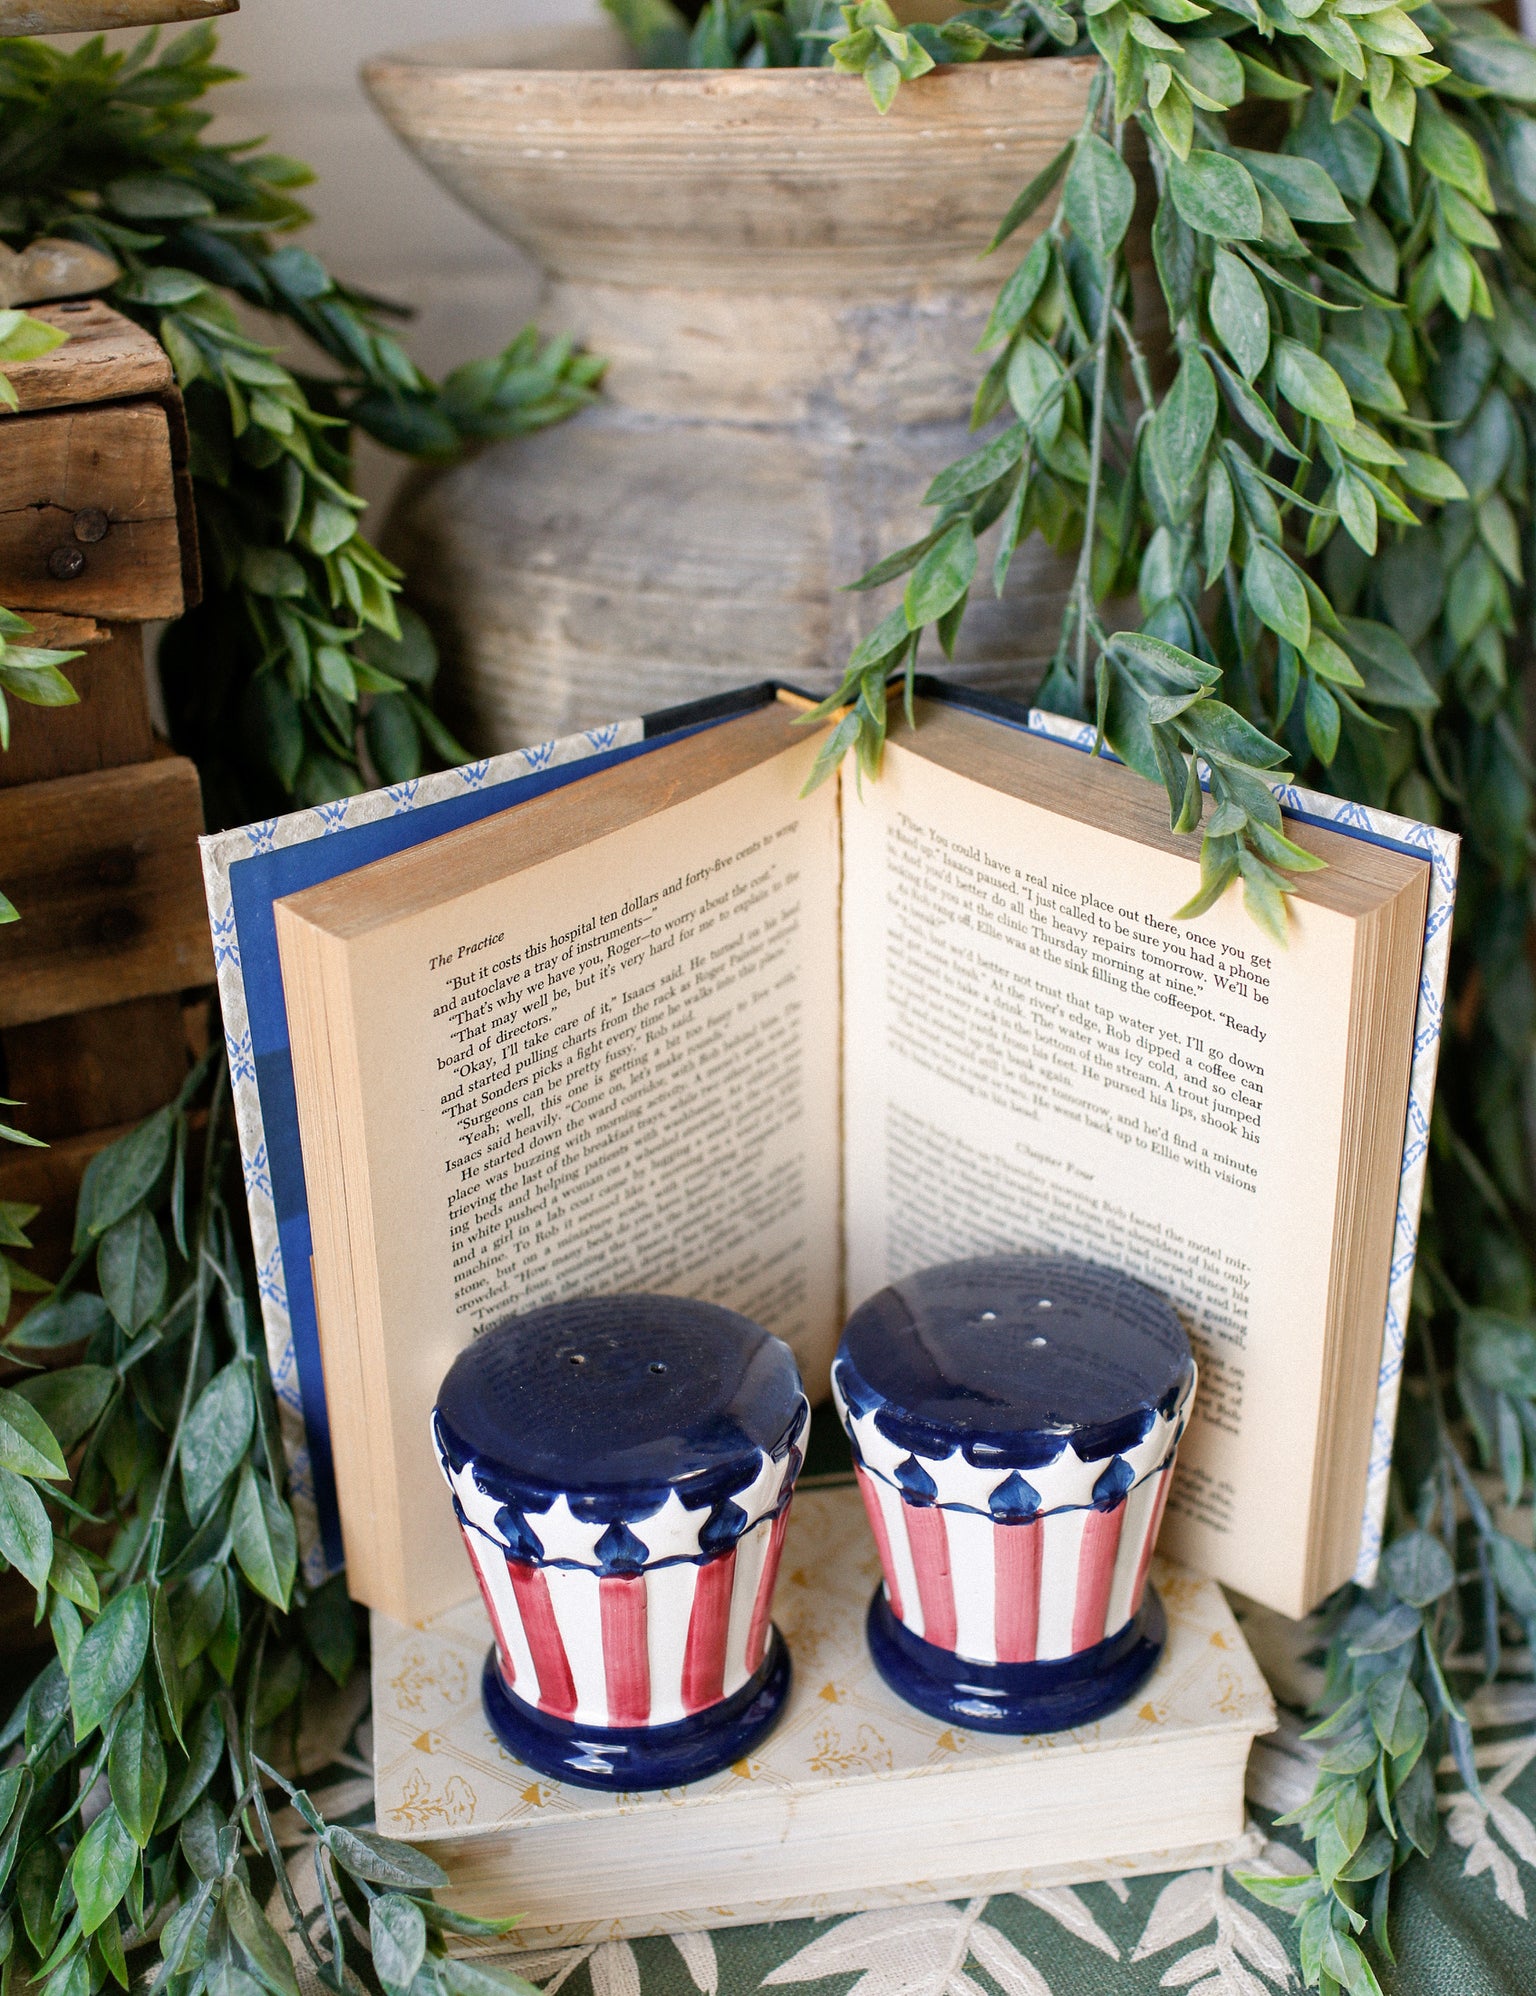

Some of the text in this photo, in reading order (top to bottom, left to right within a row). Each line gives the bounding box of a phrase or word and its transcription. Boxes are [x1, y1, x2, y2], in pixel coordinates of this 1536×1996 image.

[429, 930, 505, 971] The Practice
[478, 966, 488, 979] it
[491, 954, 521, 973] costs
[524, 942, 547, 959] this
[550, 916, 596, 948] hospital
[599, 911, 618, 925] ten
[621, 892, 659, 916] dollars
[1031, 925, 1088, 959] Thursday
[1092, 952, 1144, 980] morning
[1148, 972, 1161, 983] at
[1035, 892, 1056, 910] just
[1059, 904, 1095, 925] called
[1098, 916, 1111, 929] to
[1114, 920, 1129, 936] be
[1132, 931, 1159, 946] sure
[1162, 941, 1186, 956] you
[1189, 946, 1214, 967] had
[1218, 961, 1226, 971] a
[1229, 963, 1270, 987] phone
[1052, 884, 1272, 969] nice place out there, once you get
[432, 996, 457, 1017] and
[460, 973, 520, 1005] autoclave
[523, 968, 531, 978] a
[534, 956, 558, 973] tray
[561, 944, 573, 961] of
[491, 1010, 517, 1028] may
[522, 992, 548, 1014] well
[552, 988, 571, 1001] be,
[574, 973, 595, 991] but
[620, 951, 645, 969] very
[496, 989, 523, 1007] why
[526, 980, 544, 994] we
[547, 966, 575, 985] have
[578, 955, 603, 974] you,
[1043, 948, 1061, 965] the
[1064, 958, 1089, 975] sink
[1091, 966, 1127, 992] filling
[1130, 980, 1150, 997] the
[1153, 992, 1216, 1021] coffeepot.
[1052, 915, 1088, 941] heavy
[1092, 934, 1135, 956] repairs
[1141, 949, 1207, 982] tomorrow.
[1253, 987, 1269, 1005] be
[436, 1043, 474, 1070] board
[478, 1035, 491, 1051] of
[440, 1002, 649, 1104] and started pulling charts from the
[523, 1032, 549, 1049] take
[554, 1018, 579, 1035] care
[583, 1005, 596, 1021] of
[1066, 991, 1090, 1010] that
[1094, 1003, 1114, 1021] tap
[1118, 1014, 1155, 1033] water
[1158, 1028, 1181, 1044] yet.
[1208, 1047, 1224, 1059] go
[1228, 1052, 1264, 1076] down
[1068, 1012, 1263, 1093] edge, Rob dipped a coffee can
[481, 1076, 529, 1104] Sonders
[532, 1060, 563, 1084] picks
[566, 1056, 573, 1065] a
[576, 1039, 603, 1060] fight
[522, 1087, 544, 1102] can
[547, 1078, 562, 1090] be
[566, 1059, 601, 1085] pretty
[1058, 1025, 1263, 1110] water was icy cold, and so clear
[1116, 1064, 1261, 1127] stream. A trout jumped
[506, 1105, 534, 1125] well,
[540, 1094, 562, 1110] this
[567, 1082, 588, 1097] one
[594, 1074, 603, 1085] is
[1103, 1076, 1260, 1144] pursed his lips, shook his
[444, 1113, 561, 1173] Isaacs said heavily.
[461, 1118, 584, 1181] He started down the
[1116, 1130, 1256, 1193] up to Ellie with visions
[1117, 1114, 1139, 1129] and
[1173, 1132, 1197, 1152] find
[1201, 1147, 1209, 1157] a
[1213, 1152, 1258, 1177] minute
[447, 1145, 560, 1208] place was buzzing
[448, 1181, 518, 1220] trieving the
[449, 1188, 530, 1237] ing beds and
[451, 1222, 501, 1252] in white
[452, 1245, 487, 1268] and a
[455, 1280, 508, 1314] crowded.
